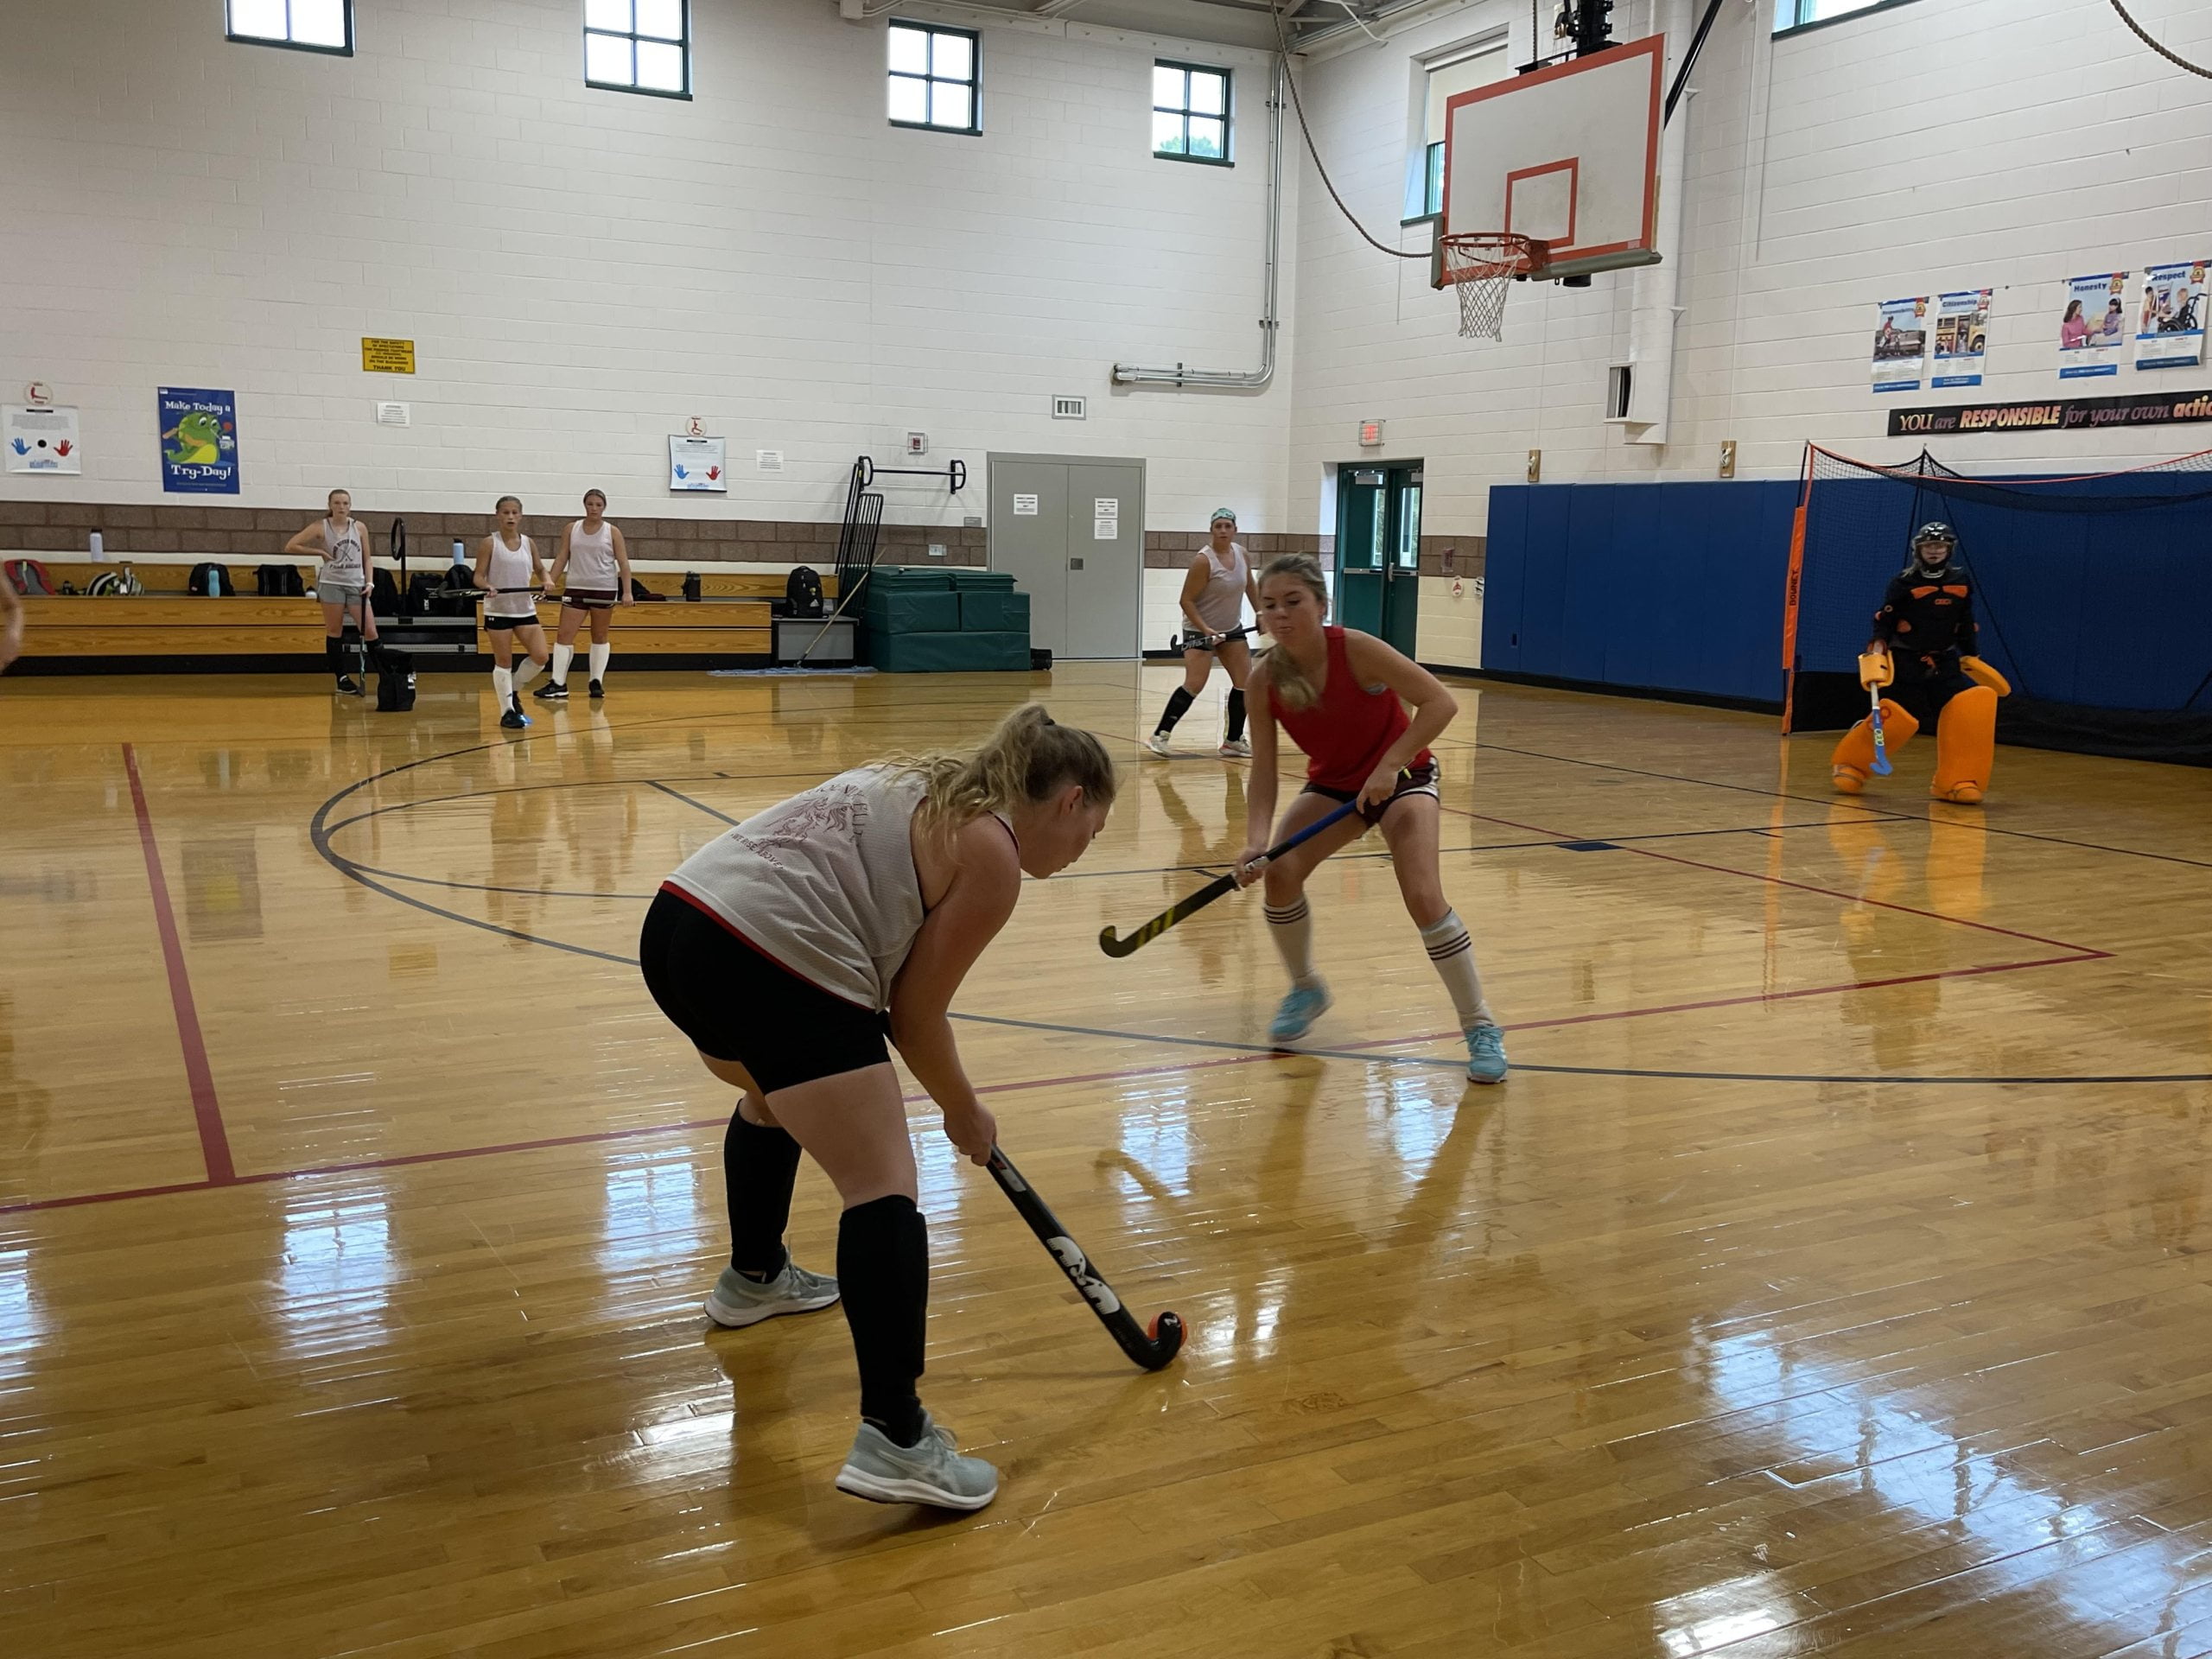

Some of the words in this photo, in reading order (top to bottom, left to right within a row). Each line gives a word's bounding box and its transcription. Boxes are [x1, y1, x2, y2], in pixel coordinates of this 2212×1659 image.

[2074, 283, 2107, 293] Honesty
[1942, 299, 1977, 308] Citizenship
[165, 401, 190, 410] Make
[193, 403, 223, 415] Today
[1900, 414, 1934, 431] YOU
[1935, 416, 1956, 429] are
[1960, 405, 2062, 429] RESPONSIBLE
[2062, 404, 2087, 429] for
[2089, 406, 2130, 428] your
[2131, 404, 2170, 421] own
[171, 464, 232, 480] Try-Day!
